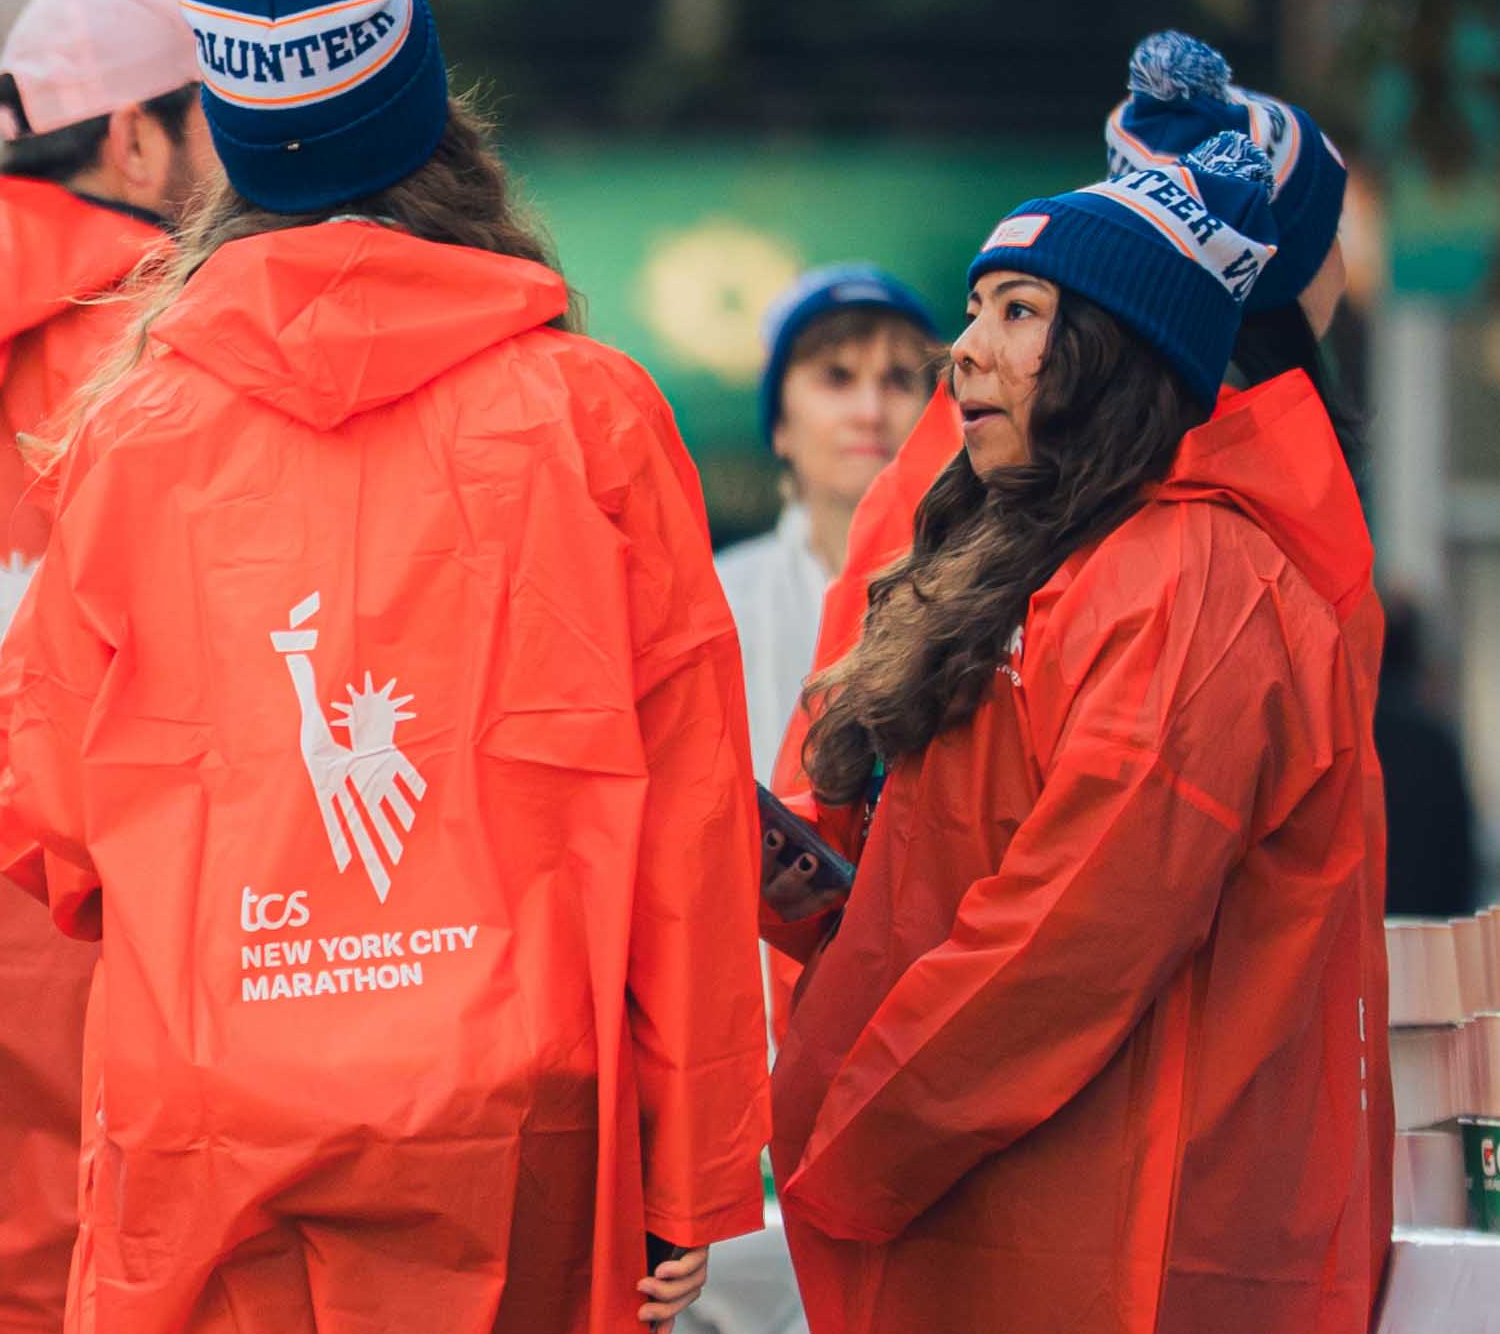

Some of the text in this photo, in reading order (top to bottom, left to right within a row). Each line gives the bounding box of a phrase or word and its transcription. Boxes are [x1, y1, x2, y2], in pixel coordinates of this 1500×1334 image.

[240, 886, 310, 932] tcs
[241, 925, 478, 970] NEW YORK CITY
[241, 962, 423, 1002] MARATHON
